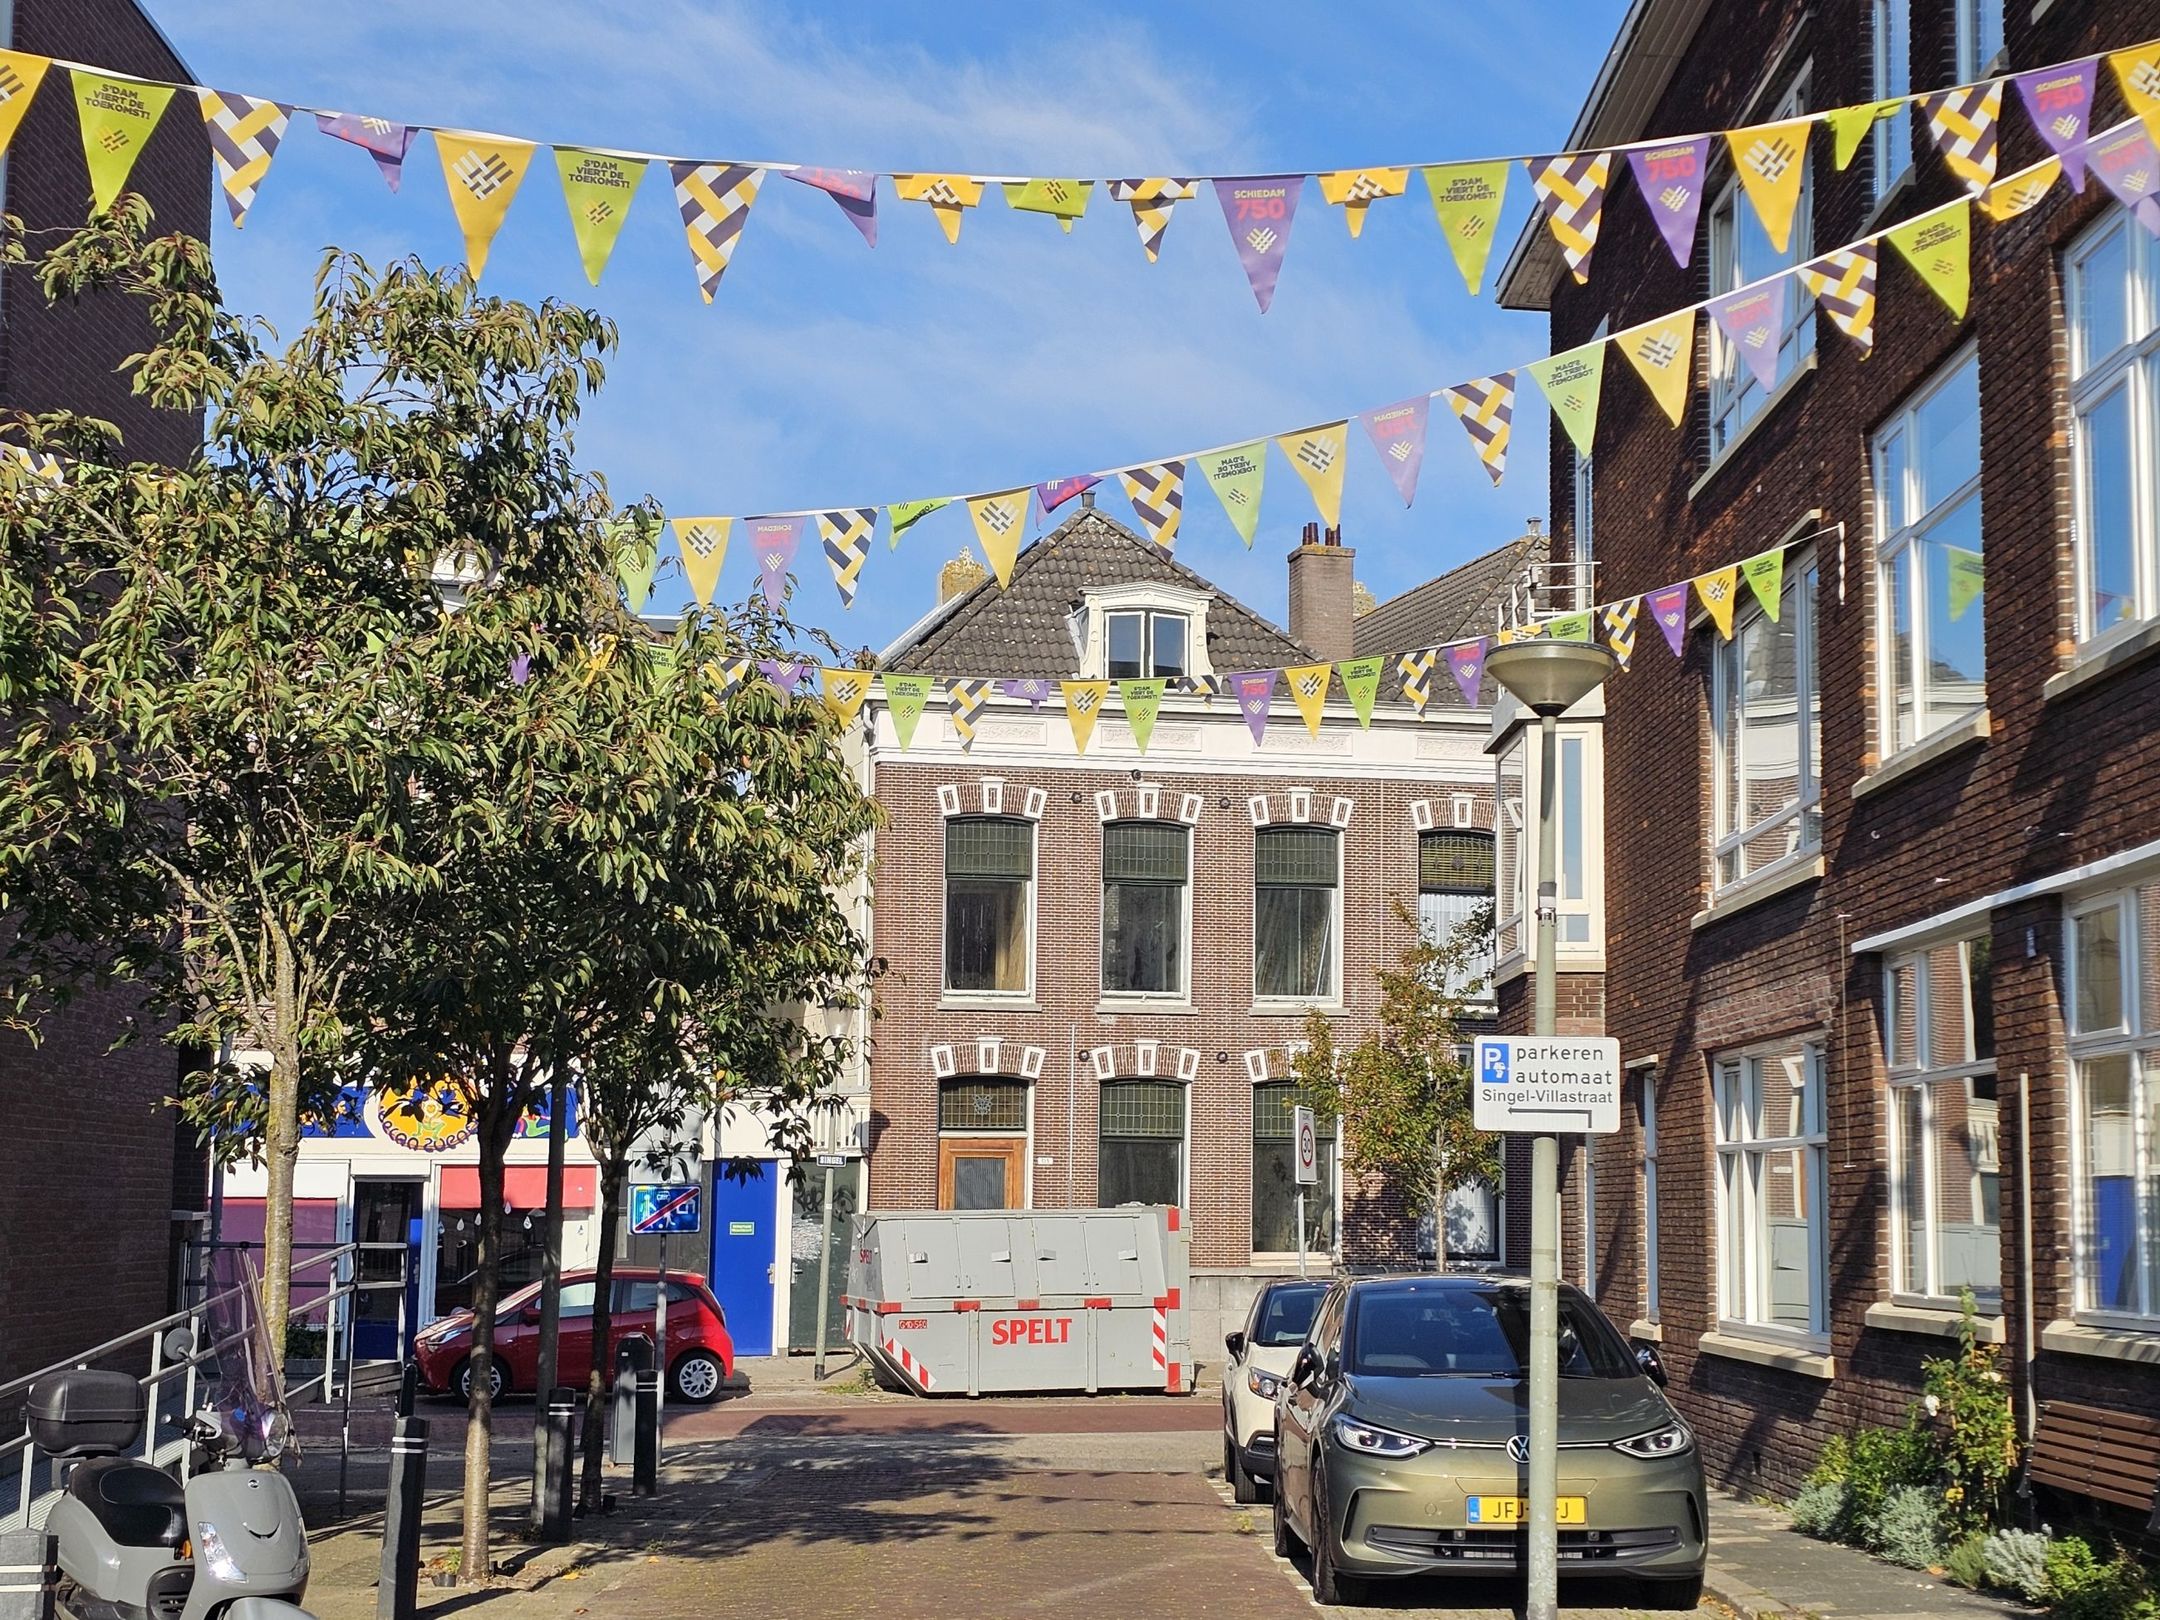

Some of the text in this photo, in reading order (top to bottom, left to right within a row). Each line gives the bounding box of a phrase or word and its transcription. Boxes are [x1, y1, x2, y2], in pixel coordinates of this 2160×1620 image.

[102, 84, 138, 99] S'DAM
[2036, 84, 2085, 112] 750
[93, 90, 144, 109] VIERT DE
[85, 97, 150, 119] TOEKOMST!
[584, 160, 617, 170] S'DAM
[1646, 155, 1696, 183] 750
[576, 167, 624, 179] VIERT DE
[568, 174, 630, 188] TOEKOMST!
[1234, 189, 1285, 198] SCHIEDAM
[1446, 184, 1489, 194] VIERT DE
[1440, 192, 1496, 202] TOEKOMST!
[1236, 198, 1285, 221] 750
[1242, 684, 1268, 696] 750
[1516, 1045, 1603, 1062] parkeren
[1516, 1070, 1612, 1084] automaat
[1482, 1089, 1612, 1104] Singel-Villastraat
[820, 1156, 843, 1164] SINGEL
[992, 1318, 1073, 1345] SPELT
